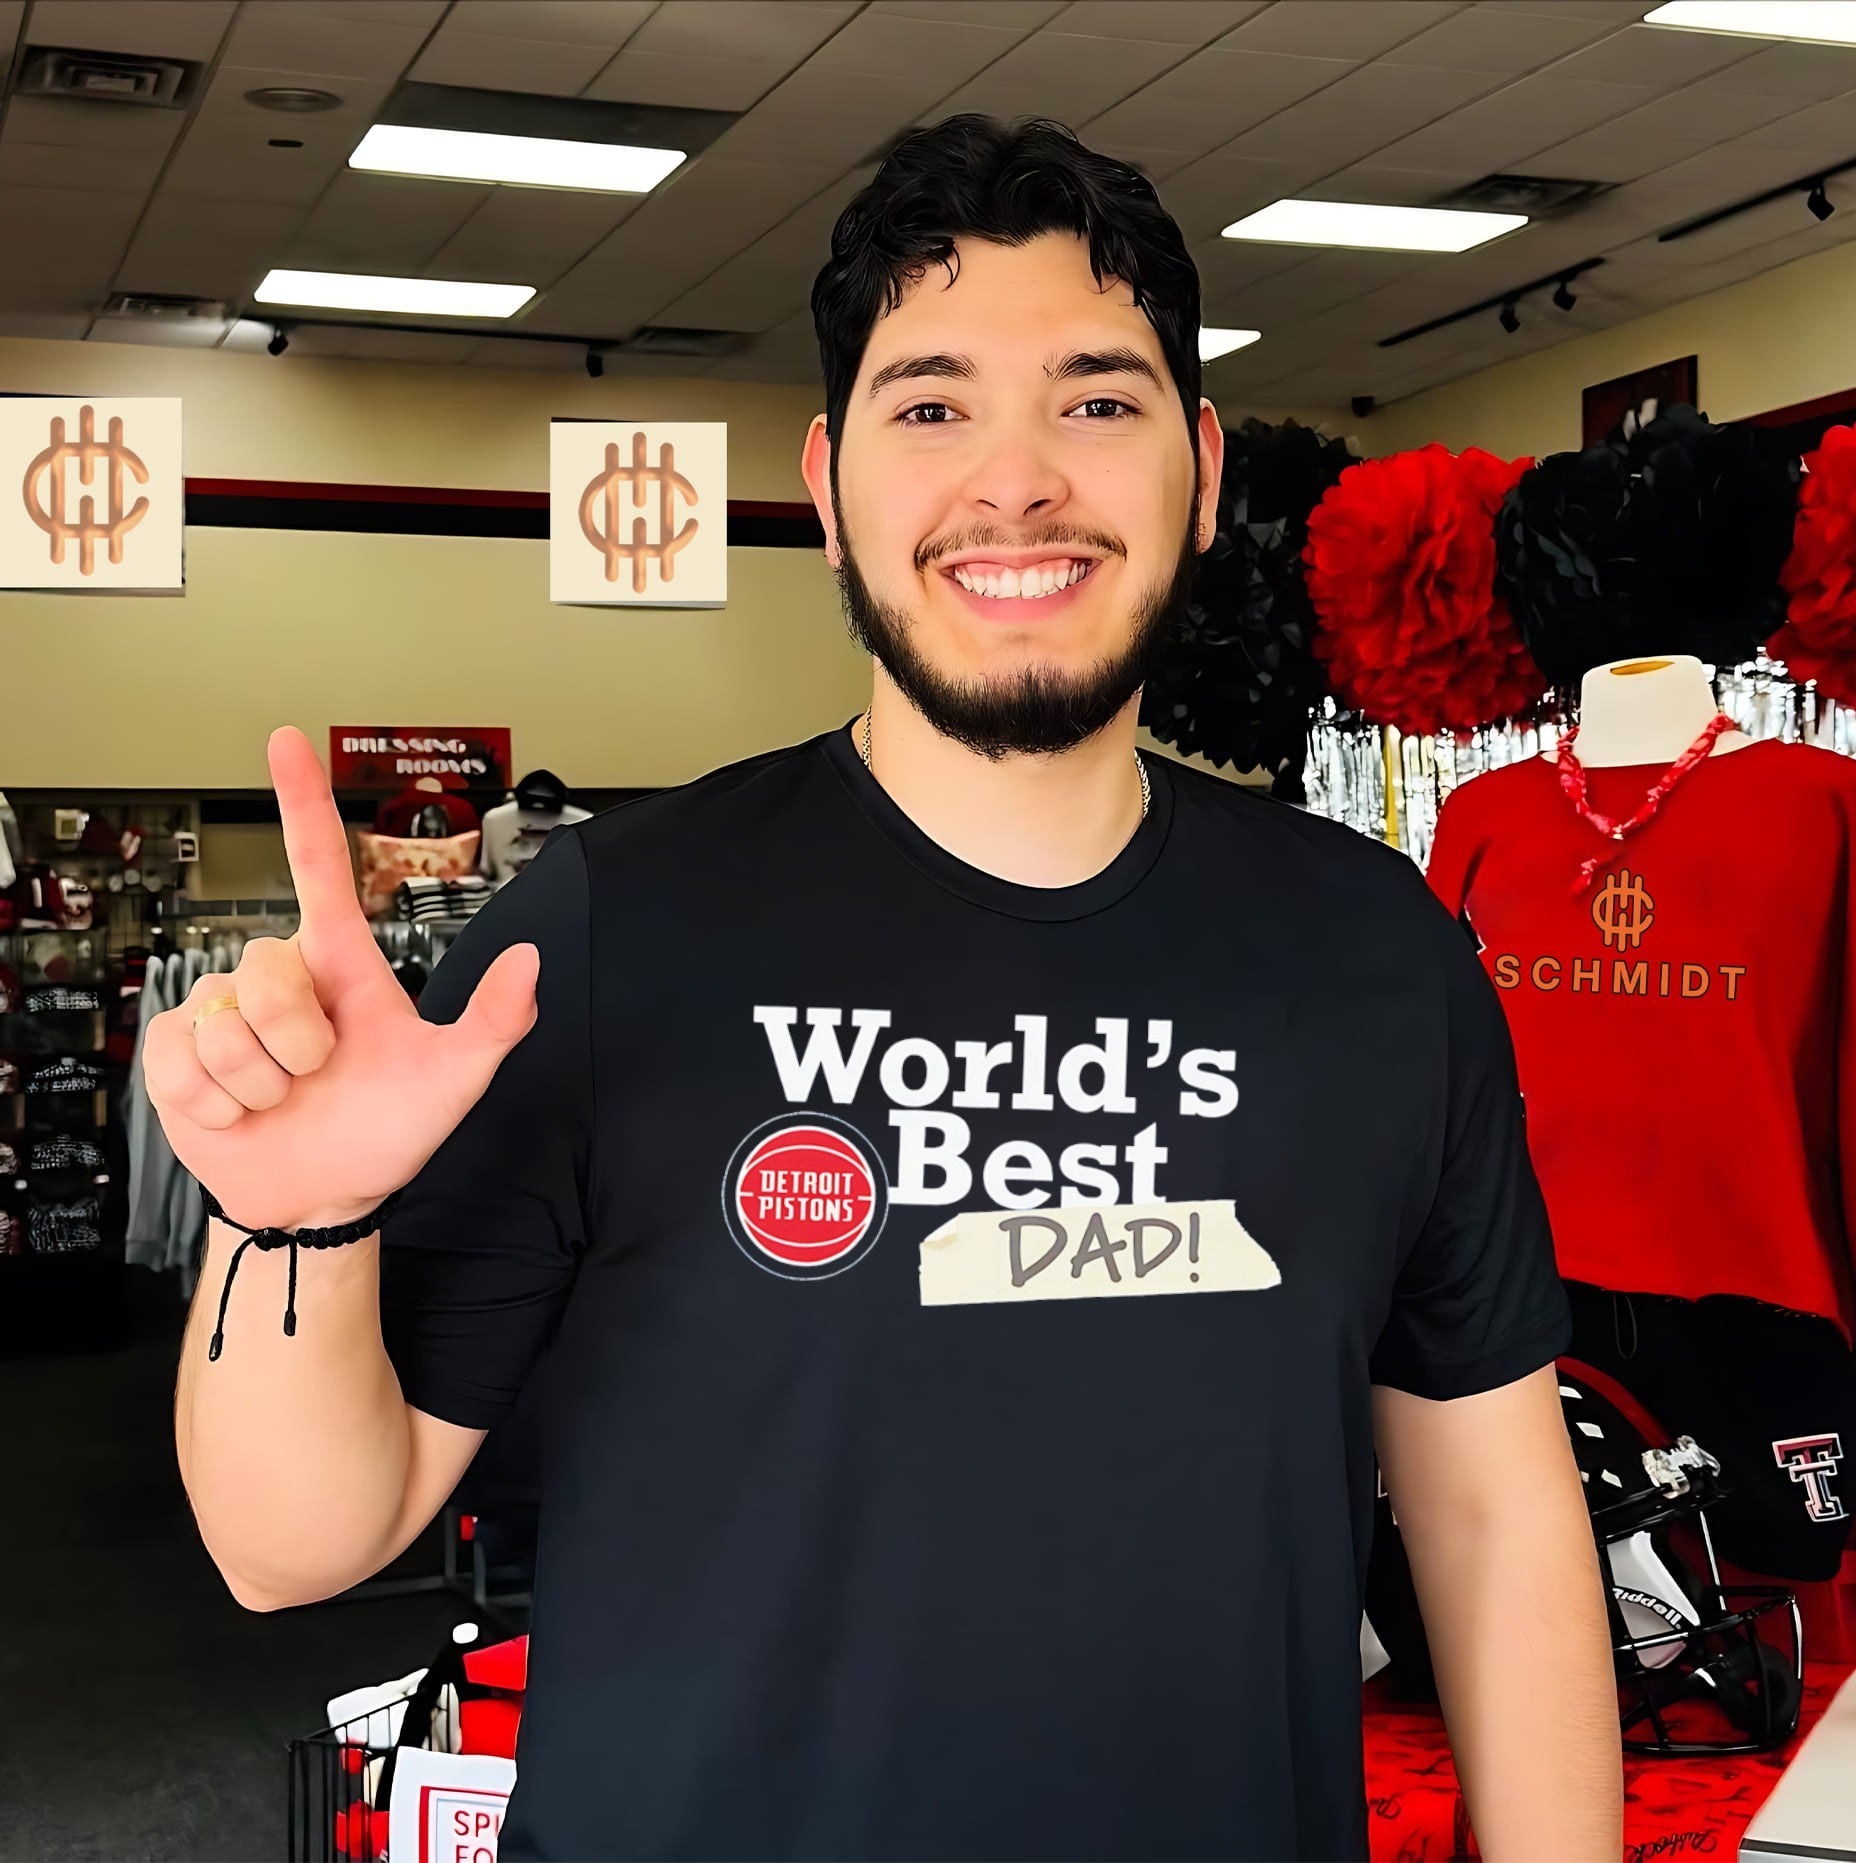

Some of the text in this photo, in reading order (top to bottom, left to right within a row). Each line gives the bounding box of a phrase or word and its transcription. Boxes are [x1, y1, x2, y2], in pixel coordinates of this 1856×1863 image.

[396, 758, 487, 774] ROOMS
[1494, 954, 1747, 1000] SCHMIDT
[753, 1005, 1239, 1118] World's
[759, 1170, 853, 1195] DETROIT
[888, 1109, 1168, 1210] Best
[758, 1196, 853, 1222] PISTONS
[999, 1212, 1200, 1287] DAD!
